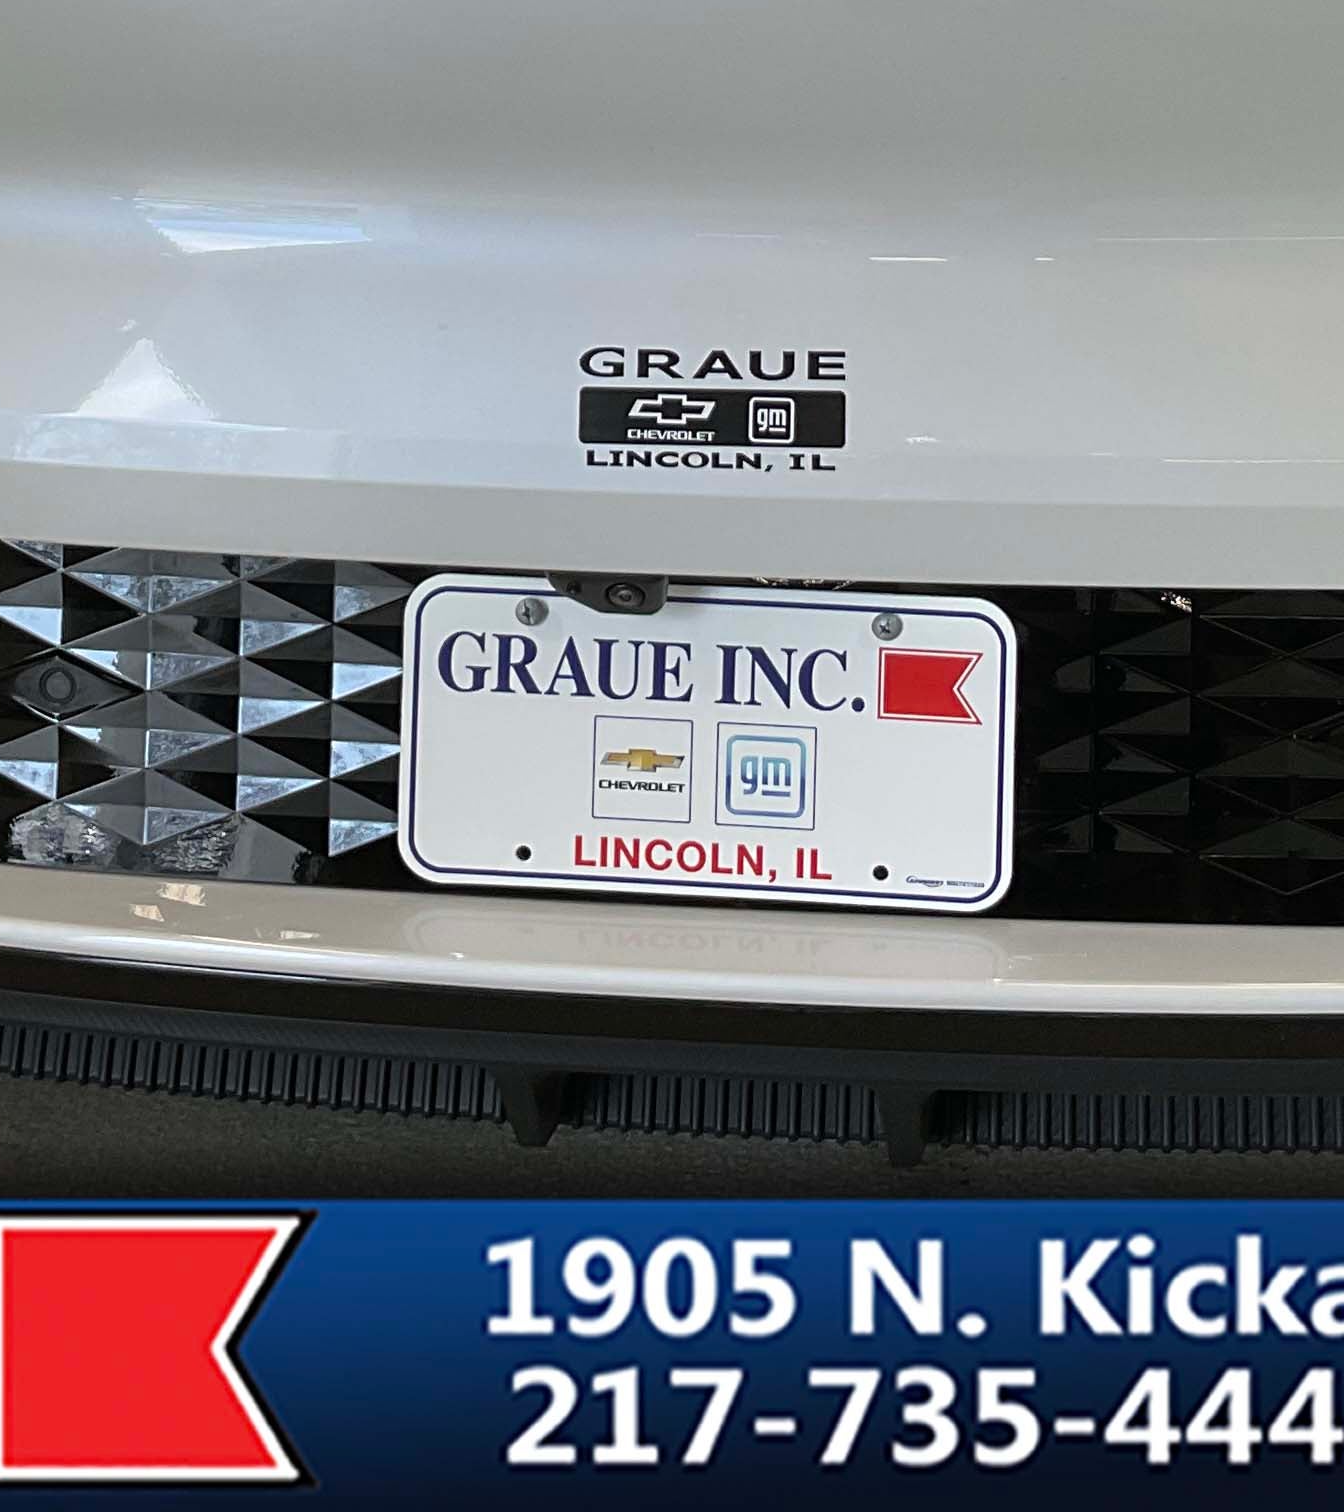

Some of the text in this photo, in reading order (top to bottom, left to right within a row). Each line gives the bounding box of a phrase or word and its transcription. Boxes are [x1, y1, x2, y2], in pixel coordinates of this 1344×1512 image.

[579, 346, 846, 381] GRAUE
[757, 408, 787, 432] gm
[627, 429, 715, 442] CHEVROLET
[586, 449, 836, 473] LINCOLN, IL
[437, 630, 865, 712] GRAUE INC.
[598, 779, 686, 793] CHEVROLET
[740, 755, 792, 797] gm
[573, 834, 833, 882] LINCOLN, IL
